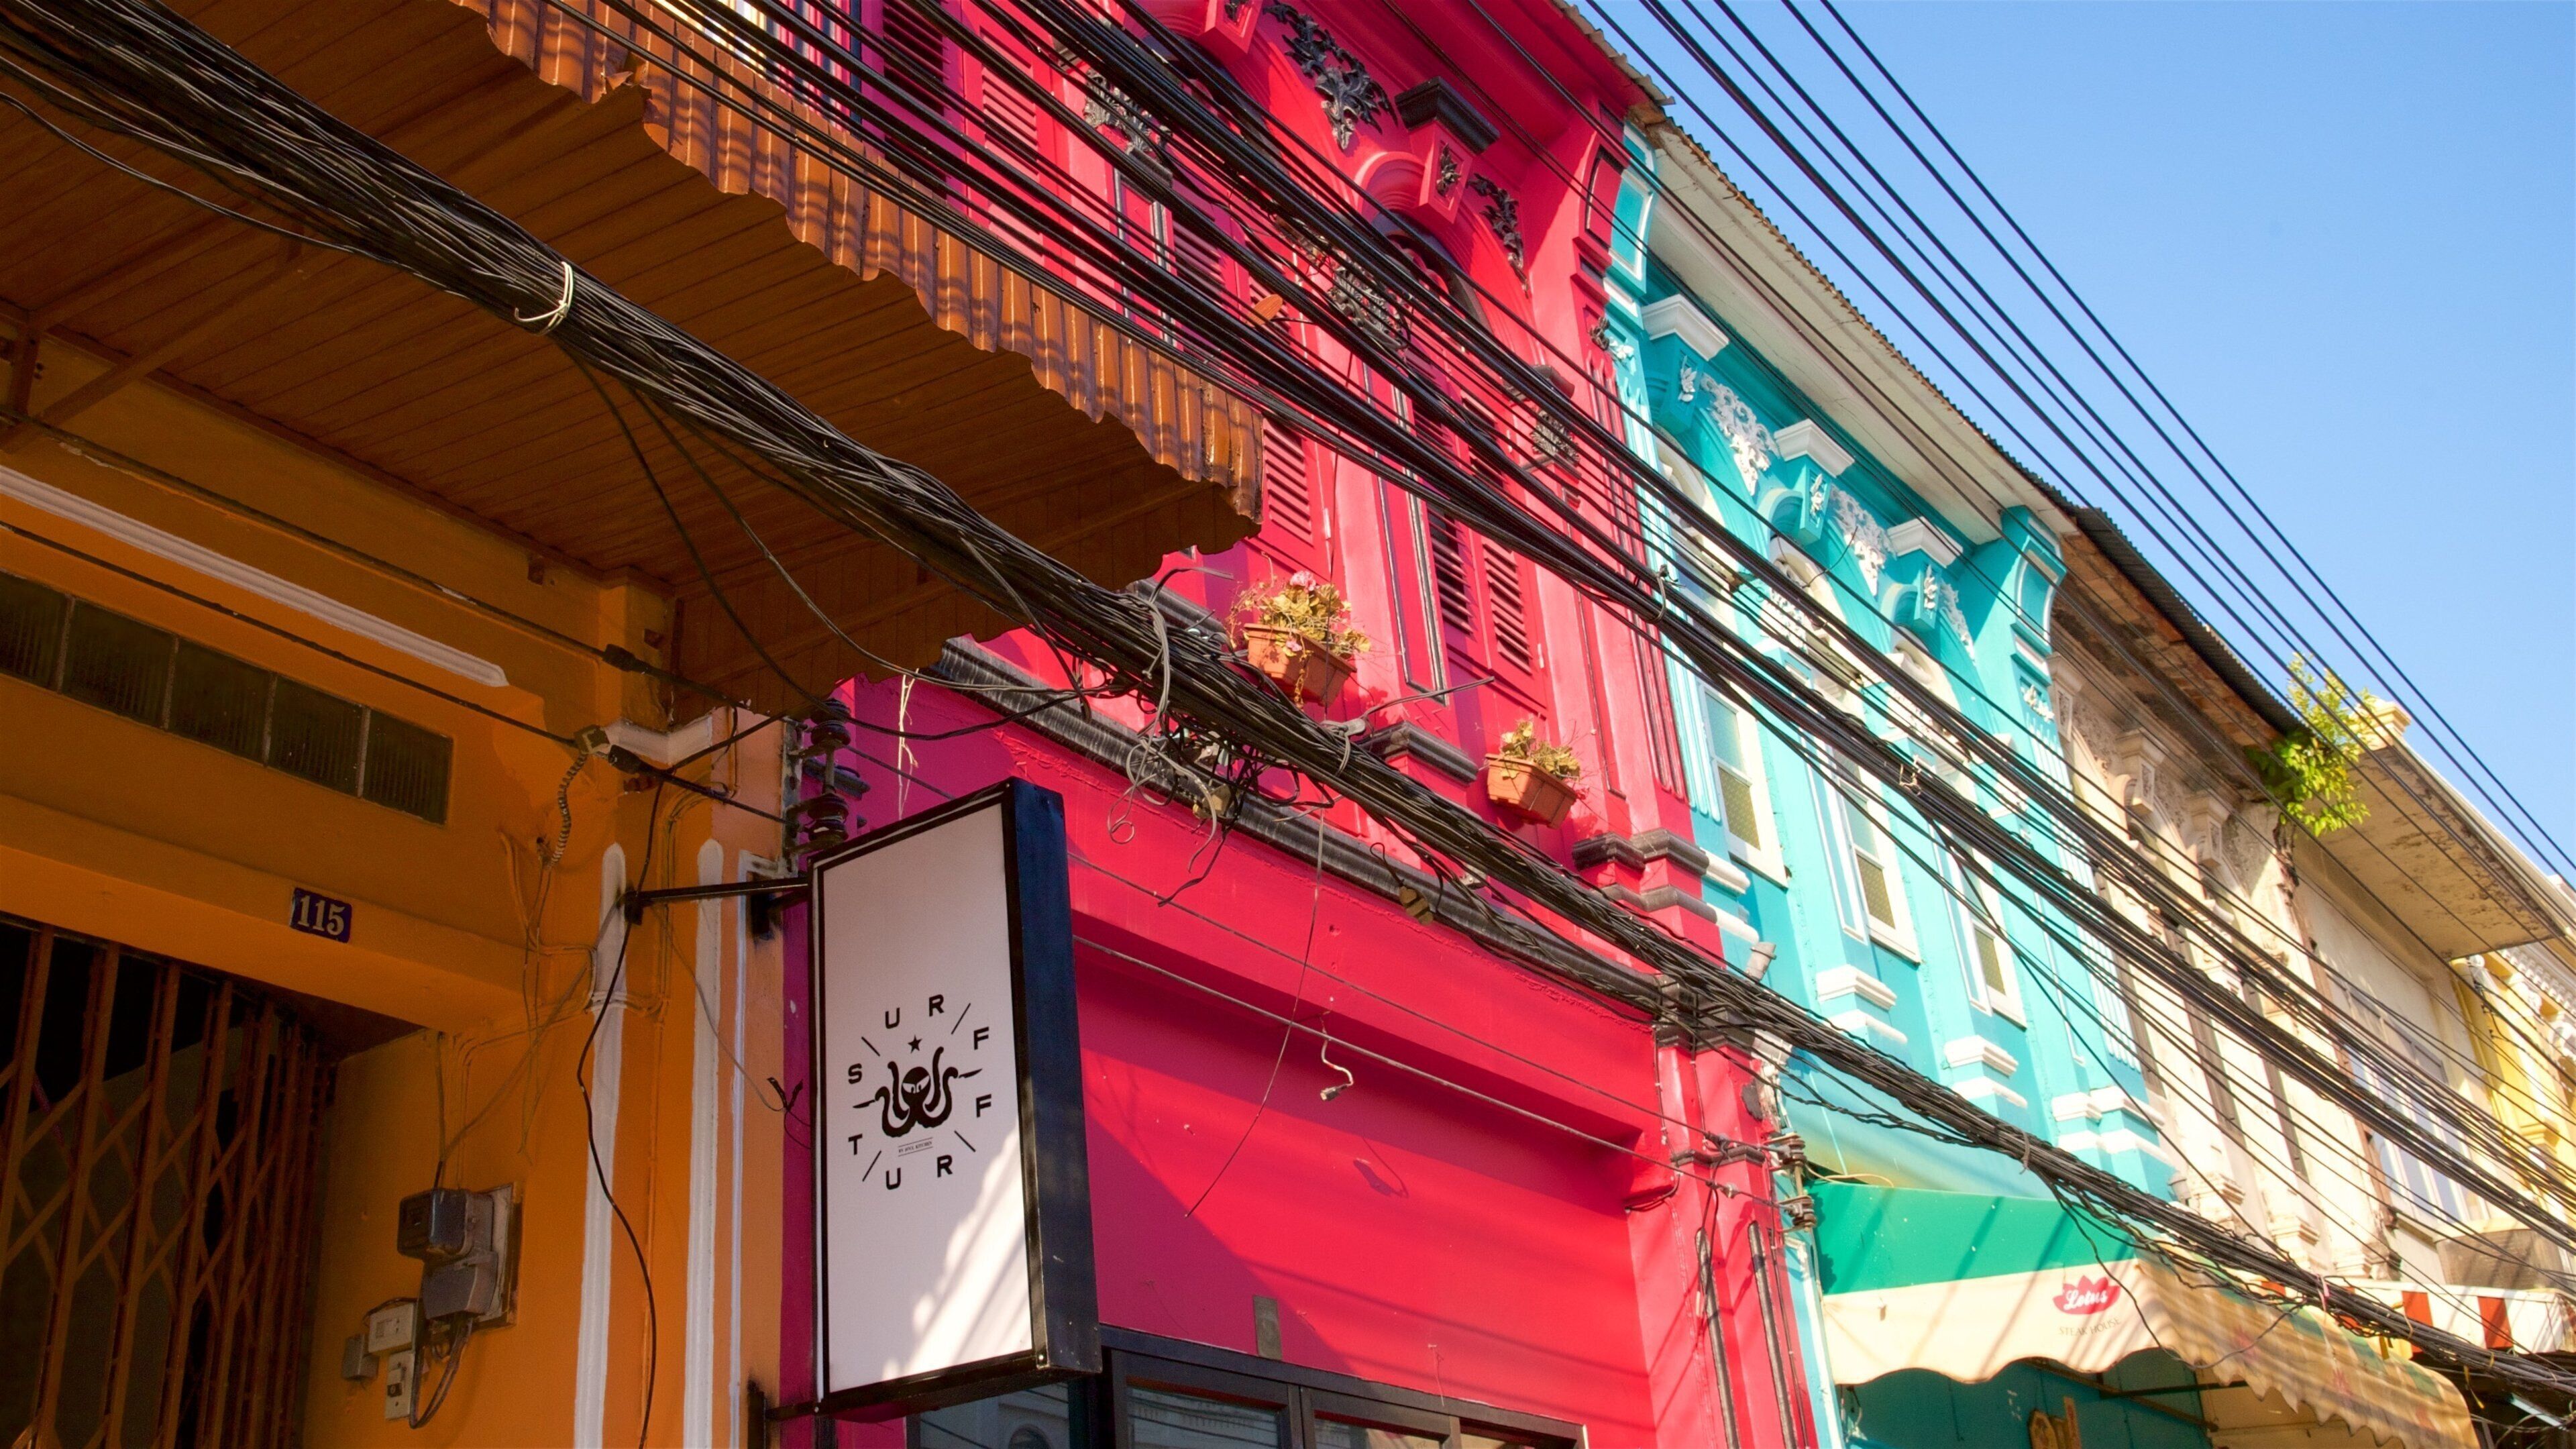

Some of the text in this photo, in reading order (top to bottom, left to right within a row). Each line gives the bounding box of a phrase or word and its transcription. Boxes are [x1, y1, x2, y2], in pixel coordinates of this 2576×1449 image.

[297, 895, 345, 936] 115
[848, 994, 989, 1085] SURF
[848, 1093, 992, 1191] TURF
[2063, 1289, 2108, 1311] Lotus
[2058, 1317, 2121, 1336] STEAK HOUSE
